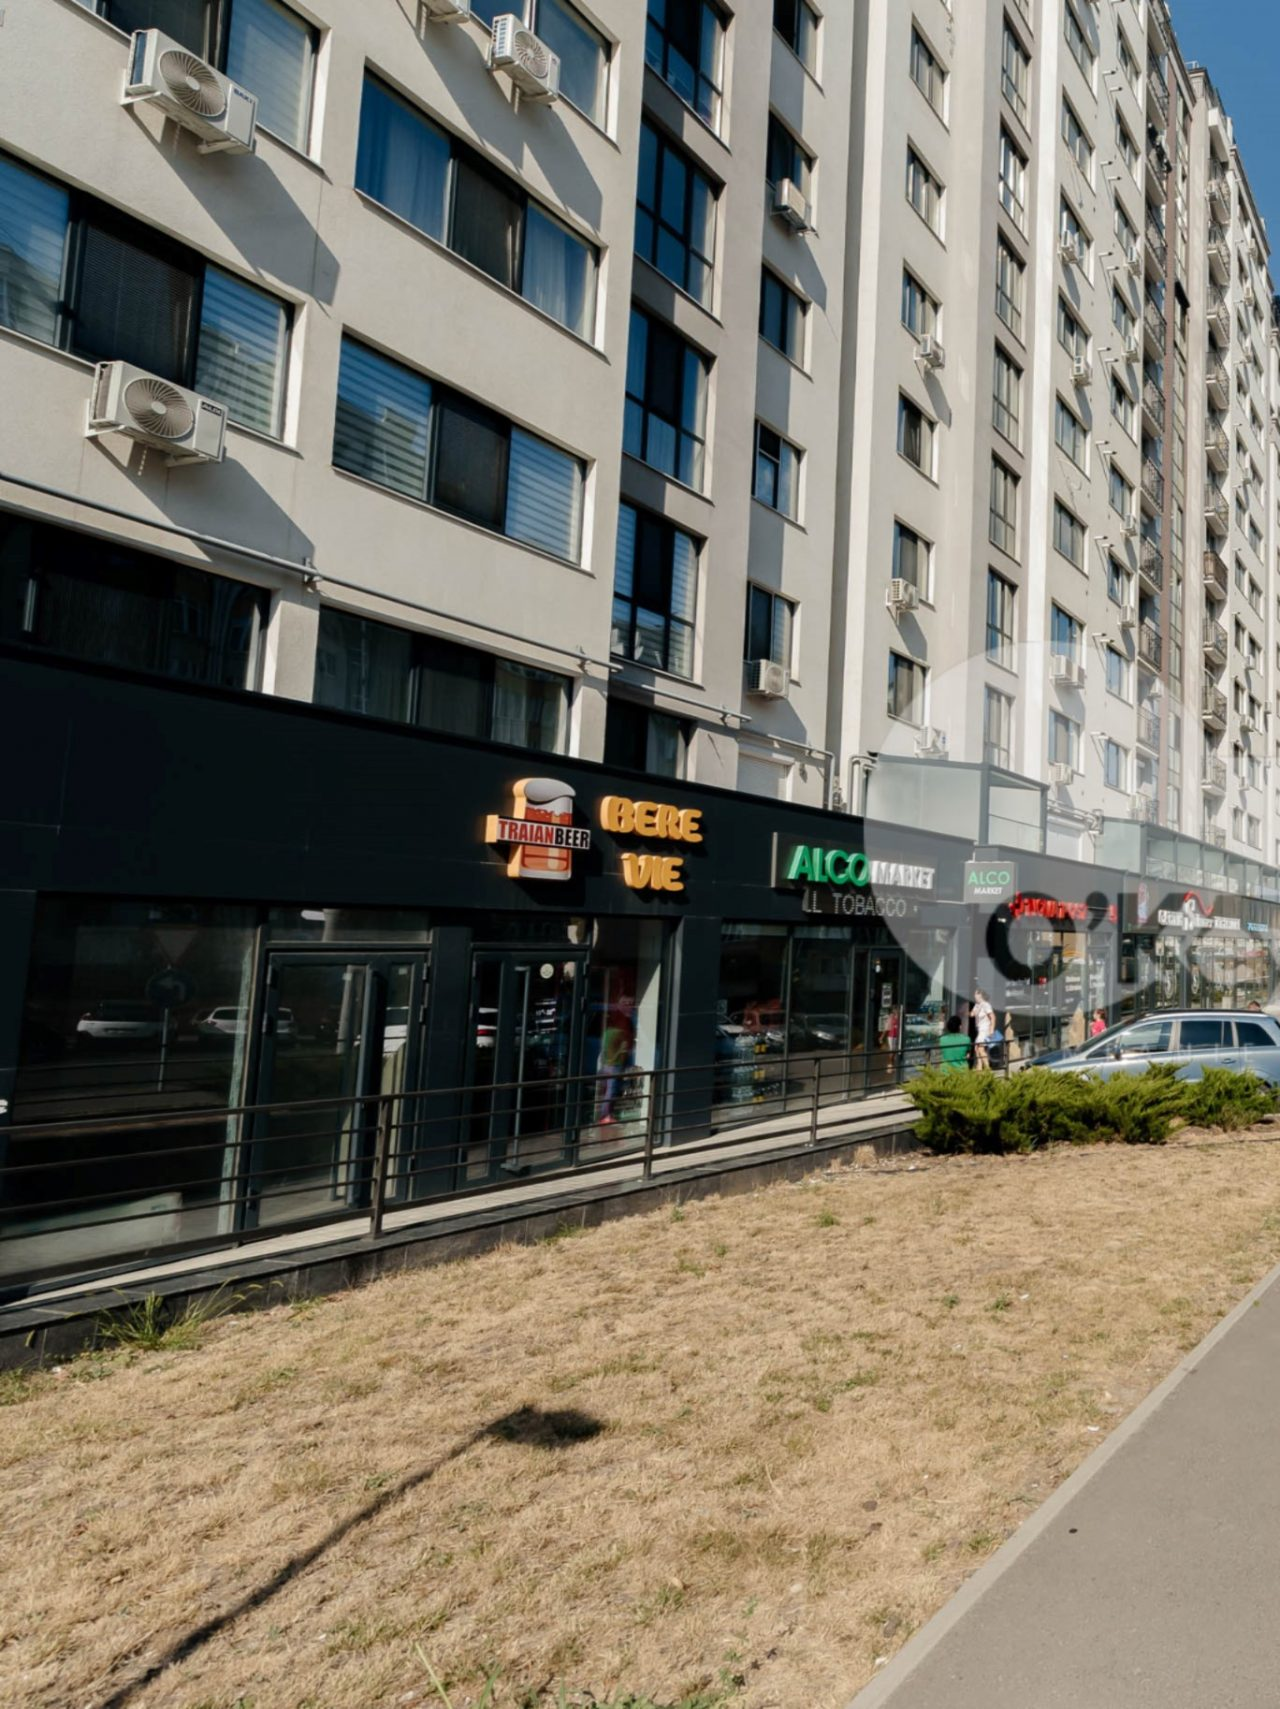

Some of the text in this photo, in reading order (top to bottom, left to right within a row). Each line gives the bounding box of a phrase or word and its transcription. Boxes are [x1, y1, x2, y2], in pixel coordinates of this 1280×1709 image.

[499, 819, 590, 849] TRAIANBEER
[600, 796, 703, 843] BERE
[621, 852, 684, 891] VIE
[787, 845, 935, 889] ALCO MARKET
[967, 870, 1011, 885] ALCO
[832, 892, 906, 917] TOBACCO
[973, 886, 1003, 896] MARKET
